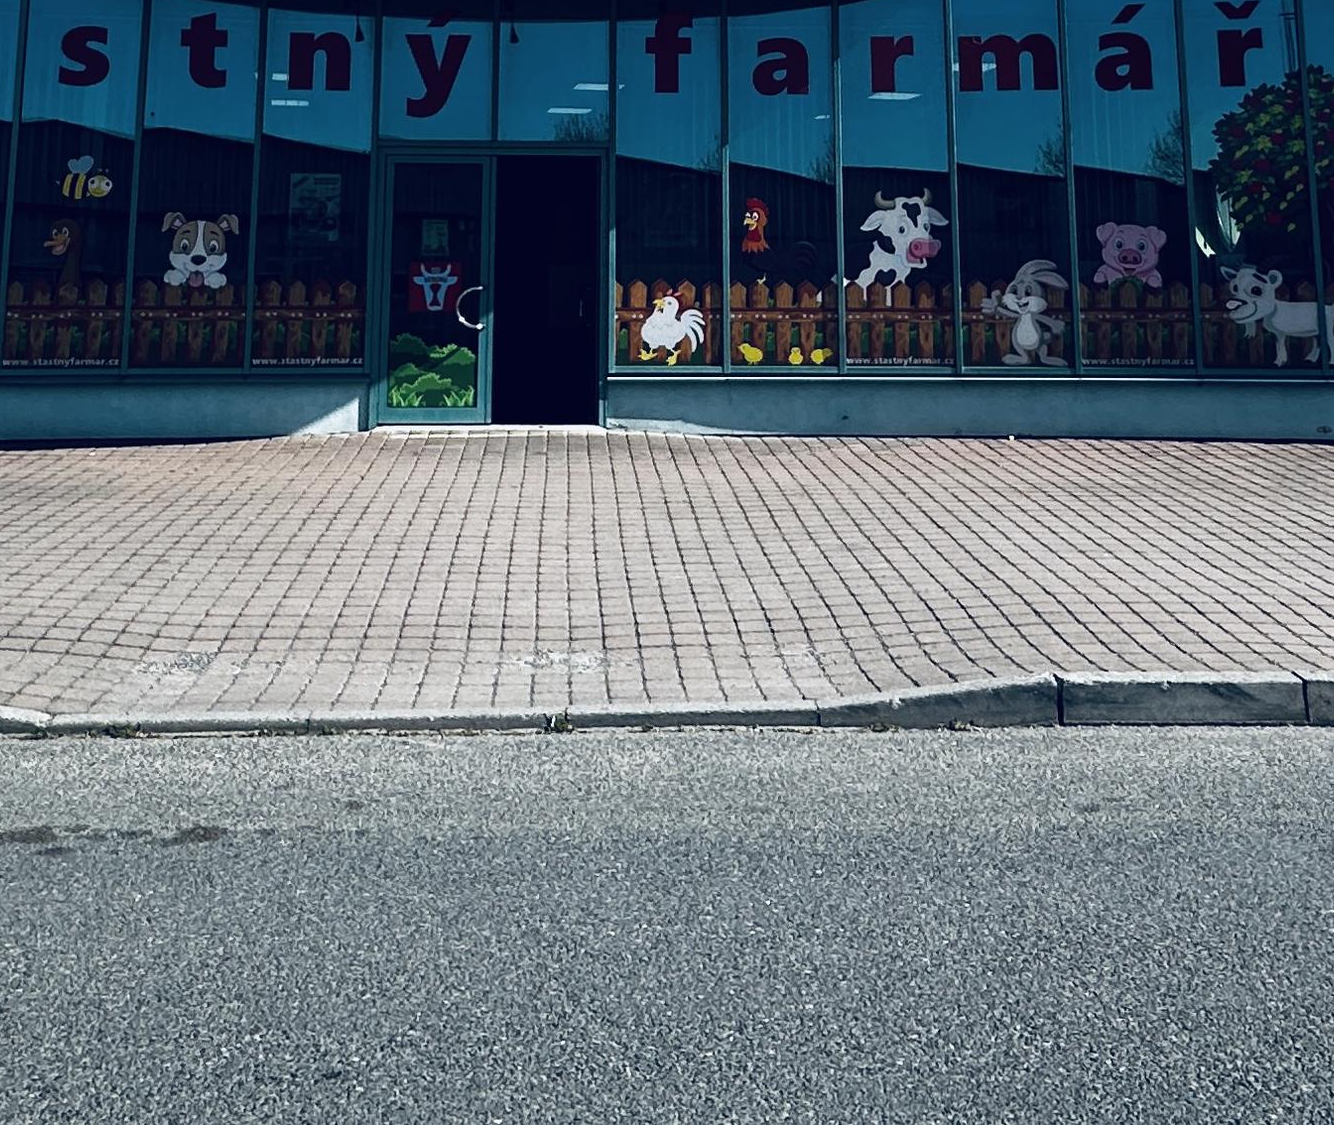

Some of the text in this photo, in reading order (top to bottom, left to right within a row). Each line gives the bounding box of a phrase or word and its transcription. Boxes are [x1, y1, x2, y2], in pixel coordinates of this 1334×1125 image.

[645, 0, 1264, 96] farmář
[2, 357, 120, 368] www.stastnyfarmar.cz
[252, 356, 364, 367] www.stastnyfarmar.cz
[845, 356, 955, 366] www.stastnyfarmar.cz
[1082, 356, 1196, 367] www.stastnyfarmar.cz
